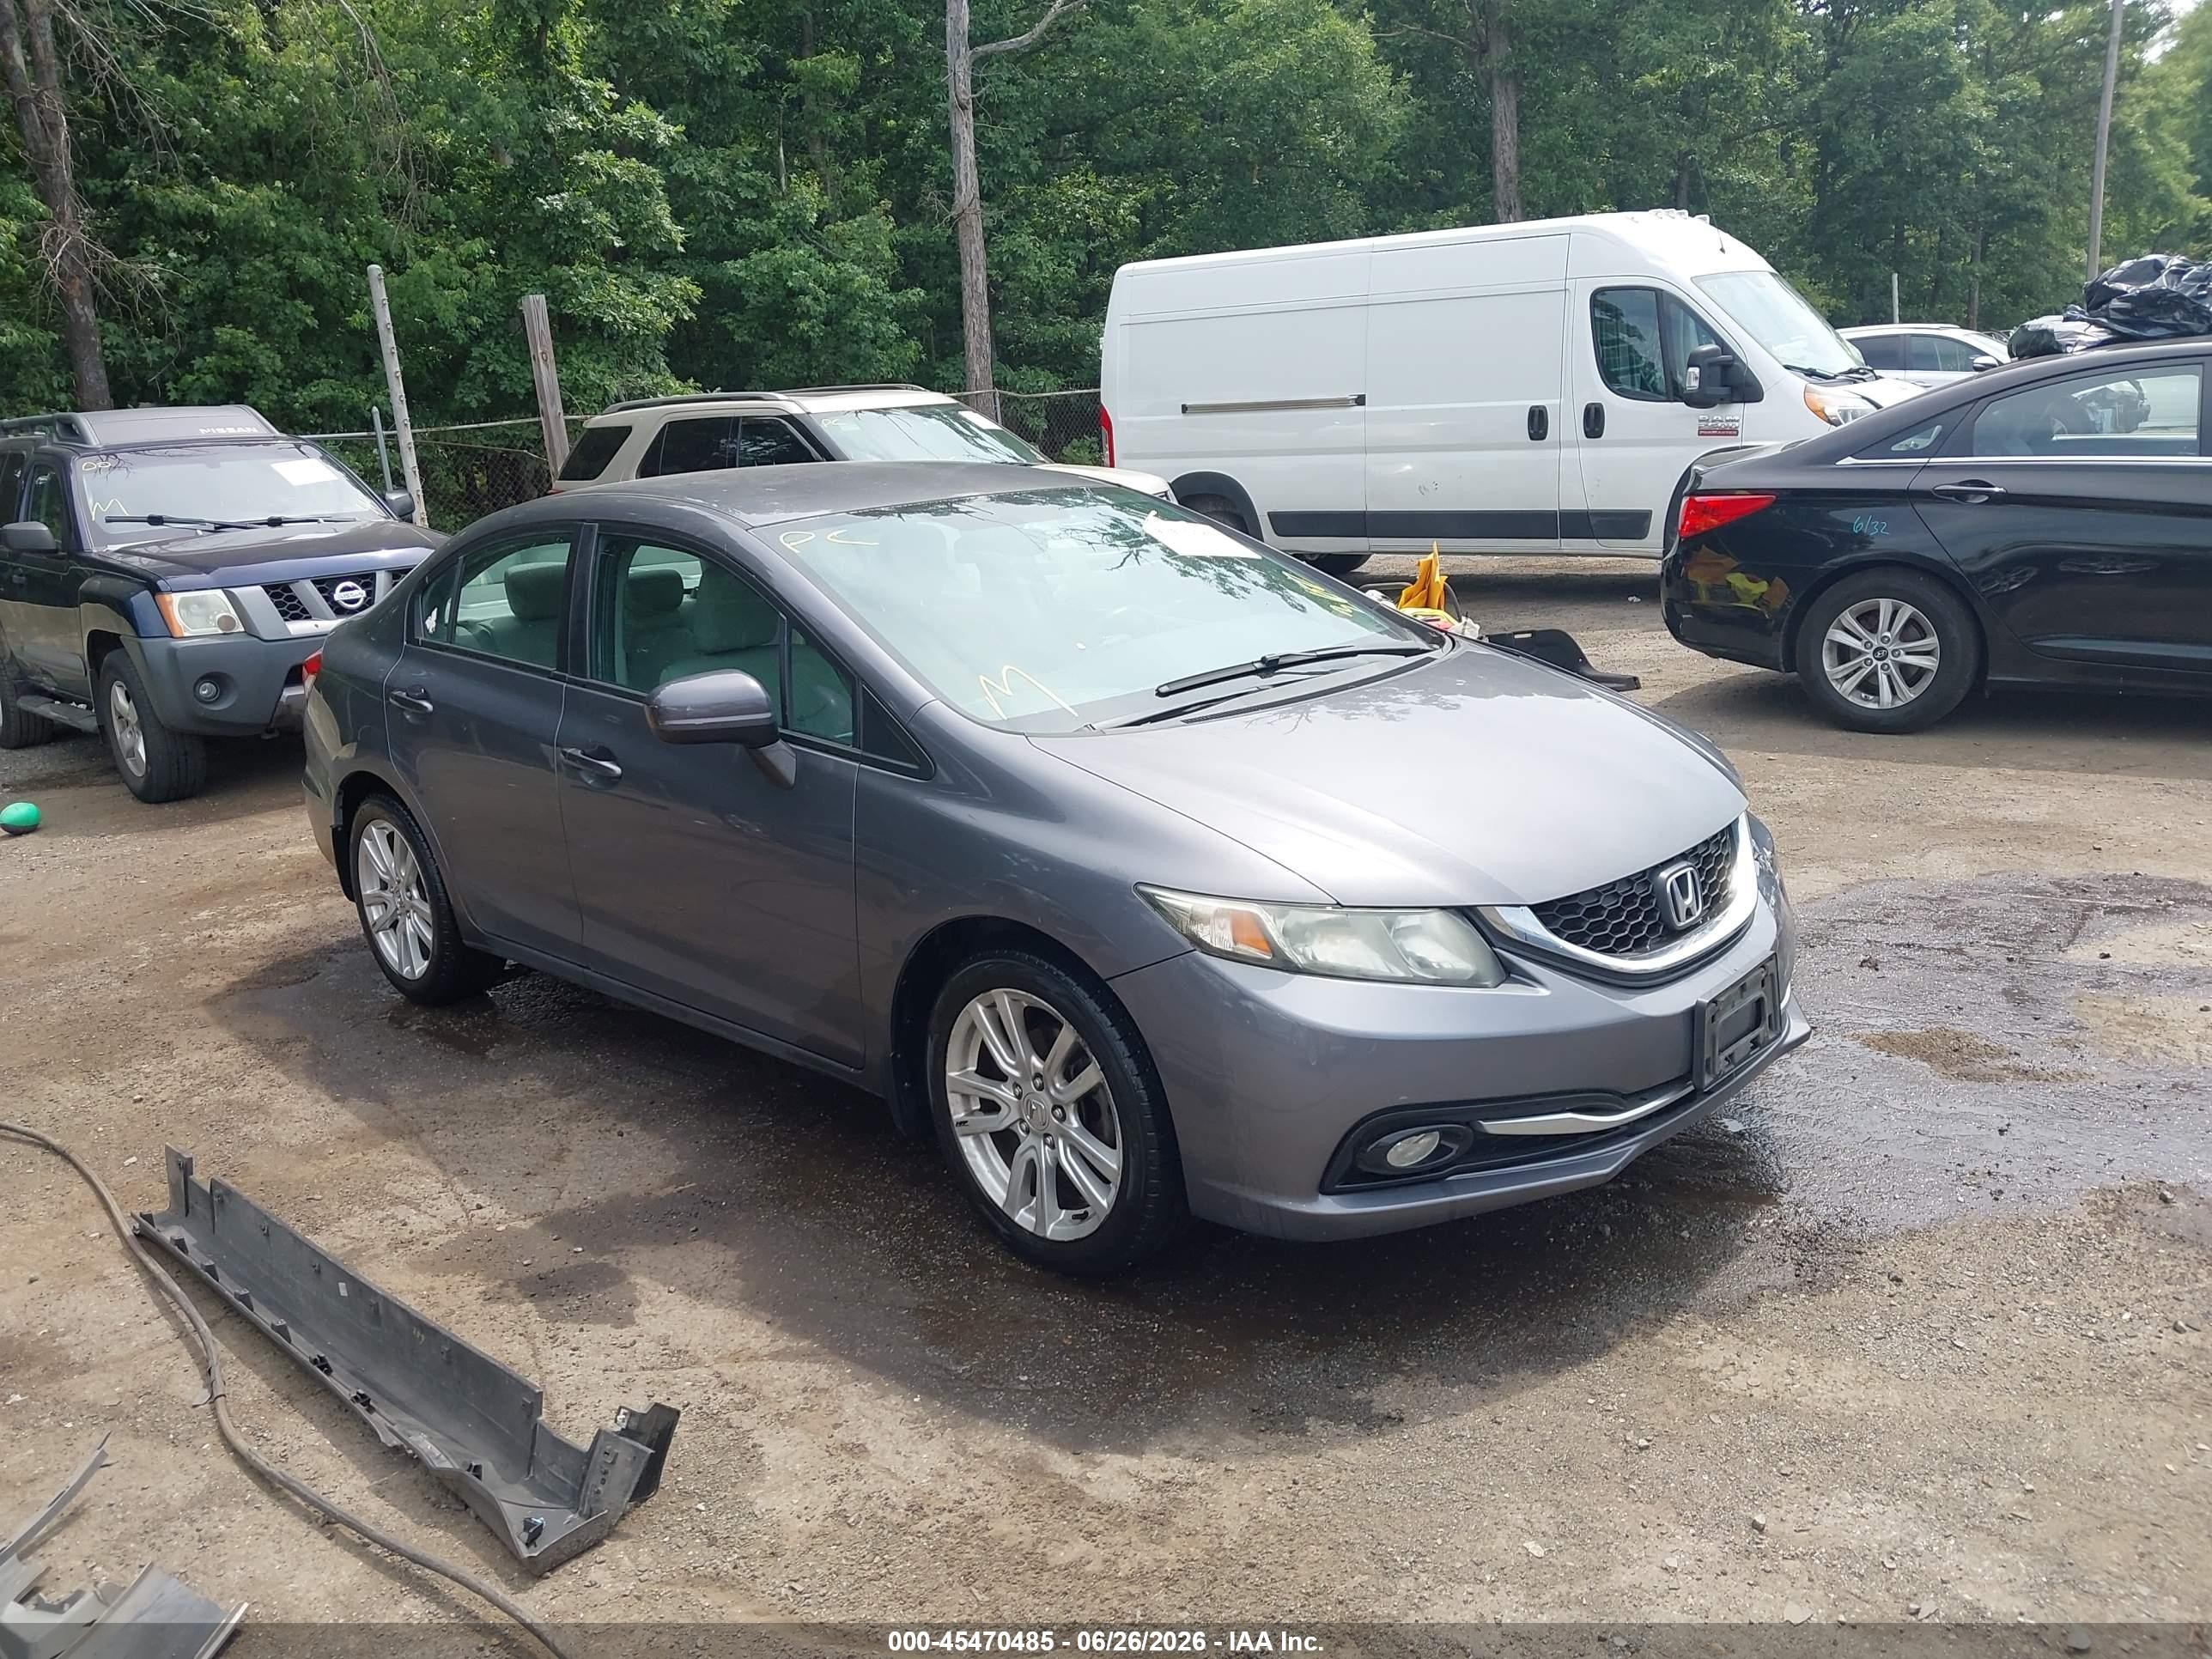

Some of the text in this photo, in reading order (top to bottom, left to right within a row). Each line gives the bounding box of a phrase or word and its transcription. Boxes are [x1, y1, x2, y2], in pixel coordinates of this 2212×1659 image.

[198, 426, 258, 434] NISSAN
[1852, 514, 1890, 536] 6/32
[978, 665, 1079, 720] M
